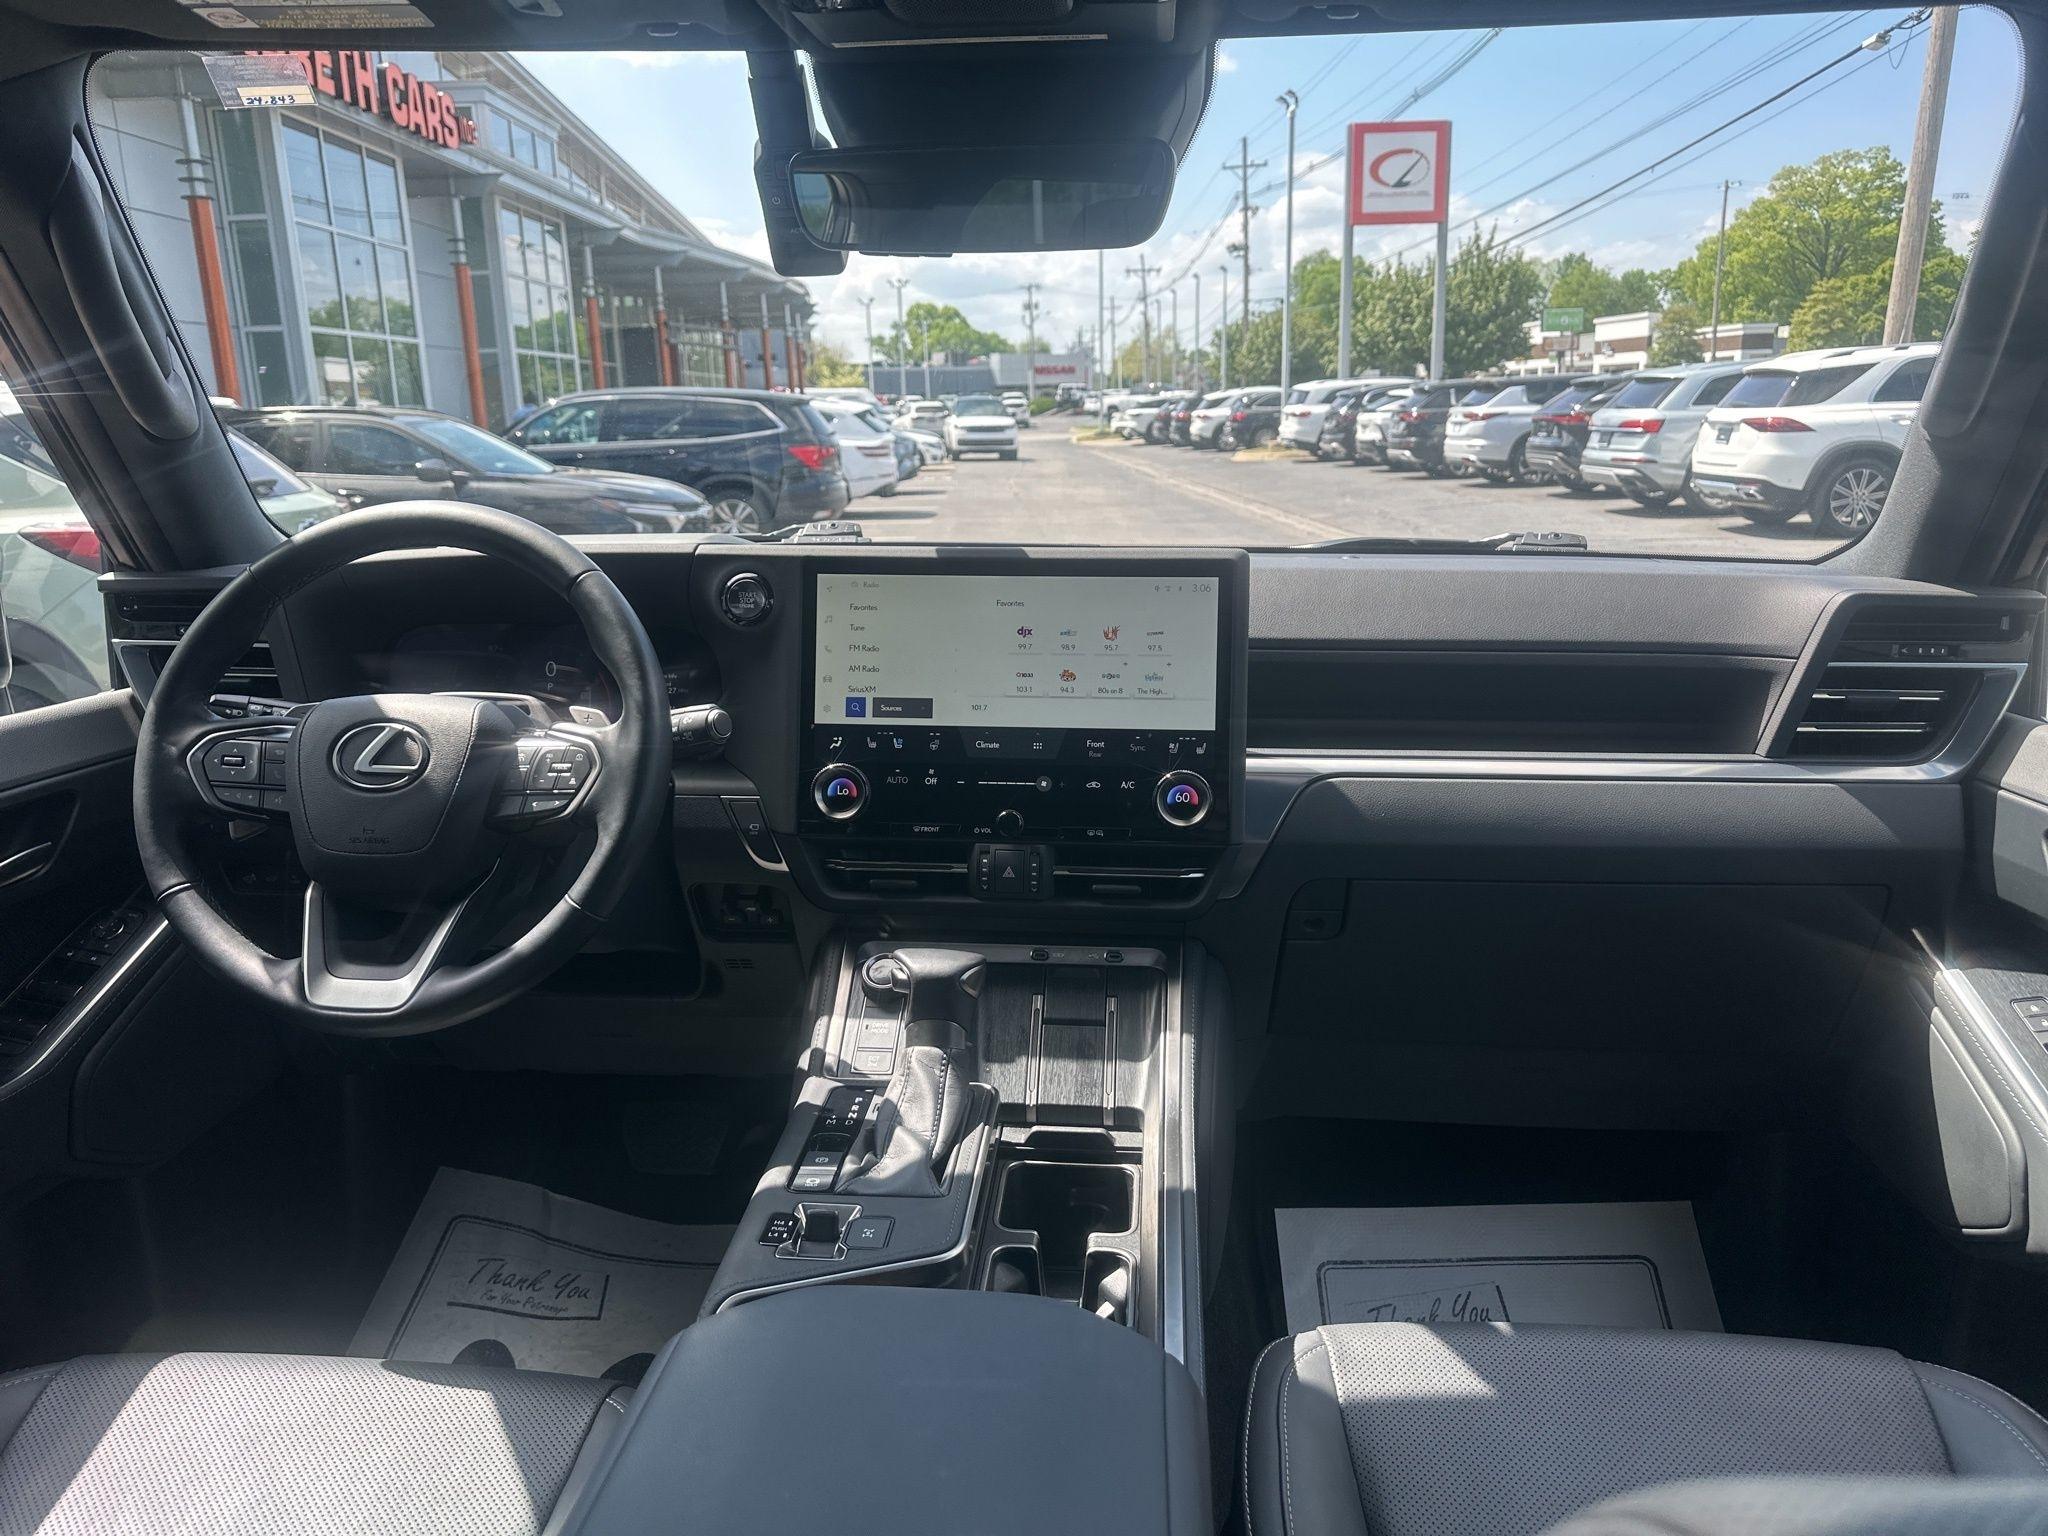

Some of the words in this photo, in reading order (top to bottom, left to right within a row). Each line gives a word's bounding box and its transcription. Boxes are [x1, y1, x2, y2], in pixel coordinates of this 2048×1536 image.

[385, 62, 460, 149] CARS
[1191, 583, 1212, 593] 3:06
[849, 603, 878, 611] Favorites
[996, 599, 1025, 608] Favorites
[849, 623, 866, 632] Tune
[849, 644, 860, 652] FM
[861, 644, 880, 652] Radio
[848, 664, 861, 672] AM
[861, 664, 880, 672] Radio
[848, 685, 877, 693] SiriusXM
[880, 704, 903, 712] Sources
[975, 740, 1000, 750] Climate
[1086, 740, 1105, 749] Front
[886, 776, 909, 785] AUTO
[925, 777, 938, 786] Off
[1120, 780, 1136, 790] A/C
[837, 785, 849, 796] Lo
[1175, 793, 1190, 804] 60
[467, 1257, 551, 1293] Thank
[554, 1272, 592, 1301] You
